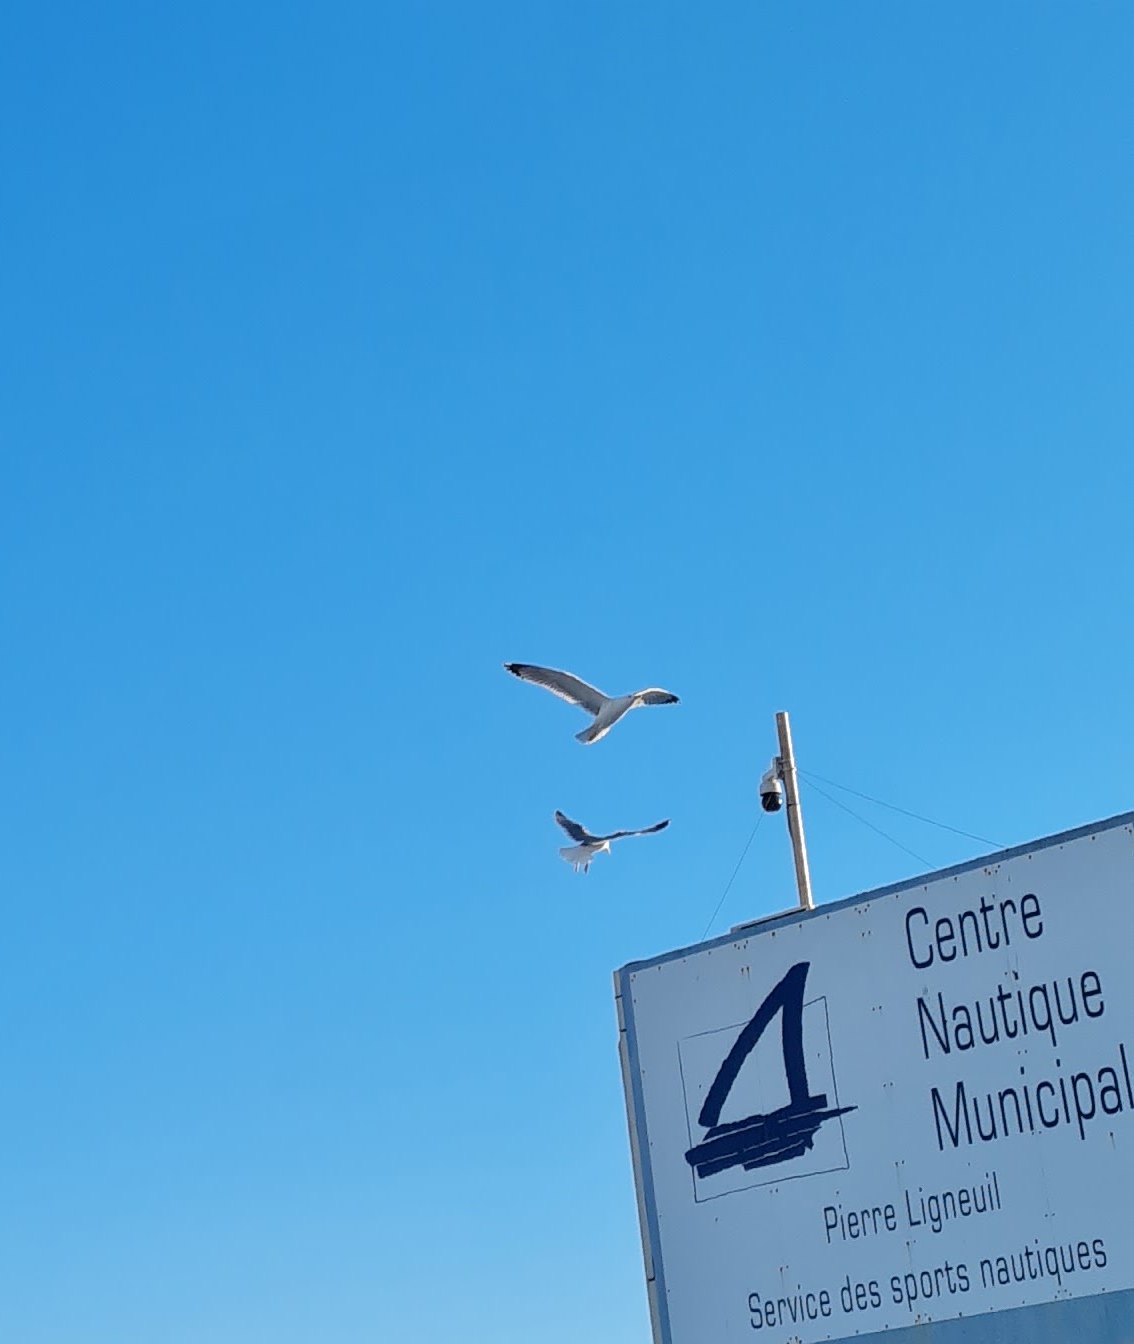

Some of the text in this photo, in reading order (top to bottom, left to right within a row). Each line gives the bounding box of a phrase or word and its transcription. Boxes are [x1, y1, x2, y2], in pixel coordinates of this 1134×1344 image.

[905, 893, 1044, 970] Centre
[916, 970, 1106, 1060] Nautique
[930, 1042, 1134, 1152] Municipal
[823, 1171, 1001, 1244] Pierre Ligneuil
[748, 1238, 1107, 1330] Service des sports nautiques
